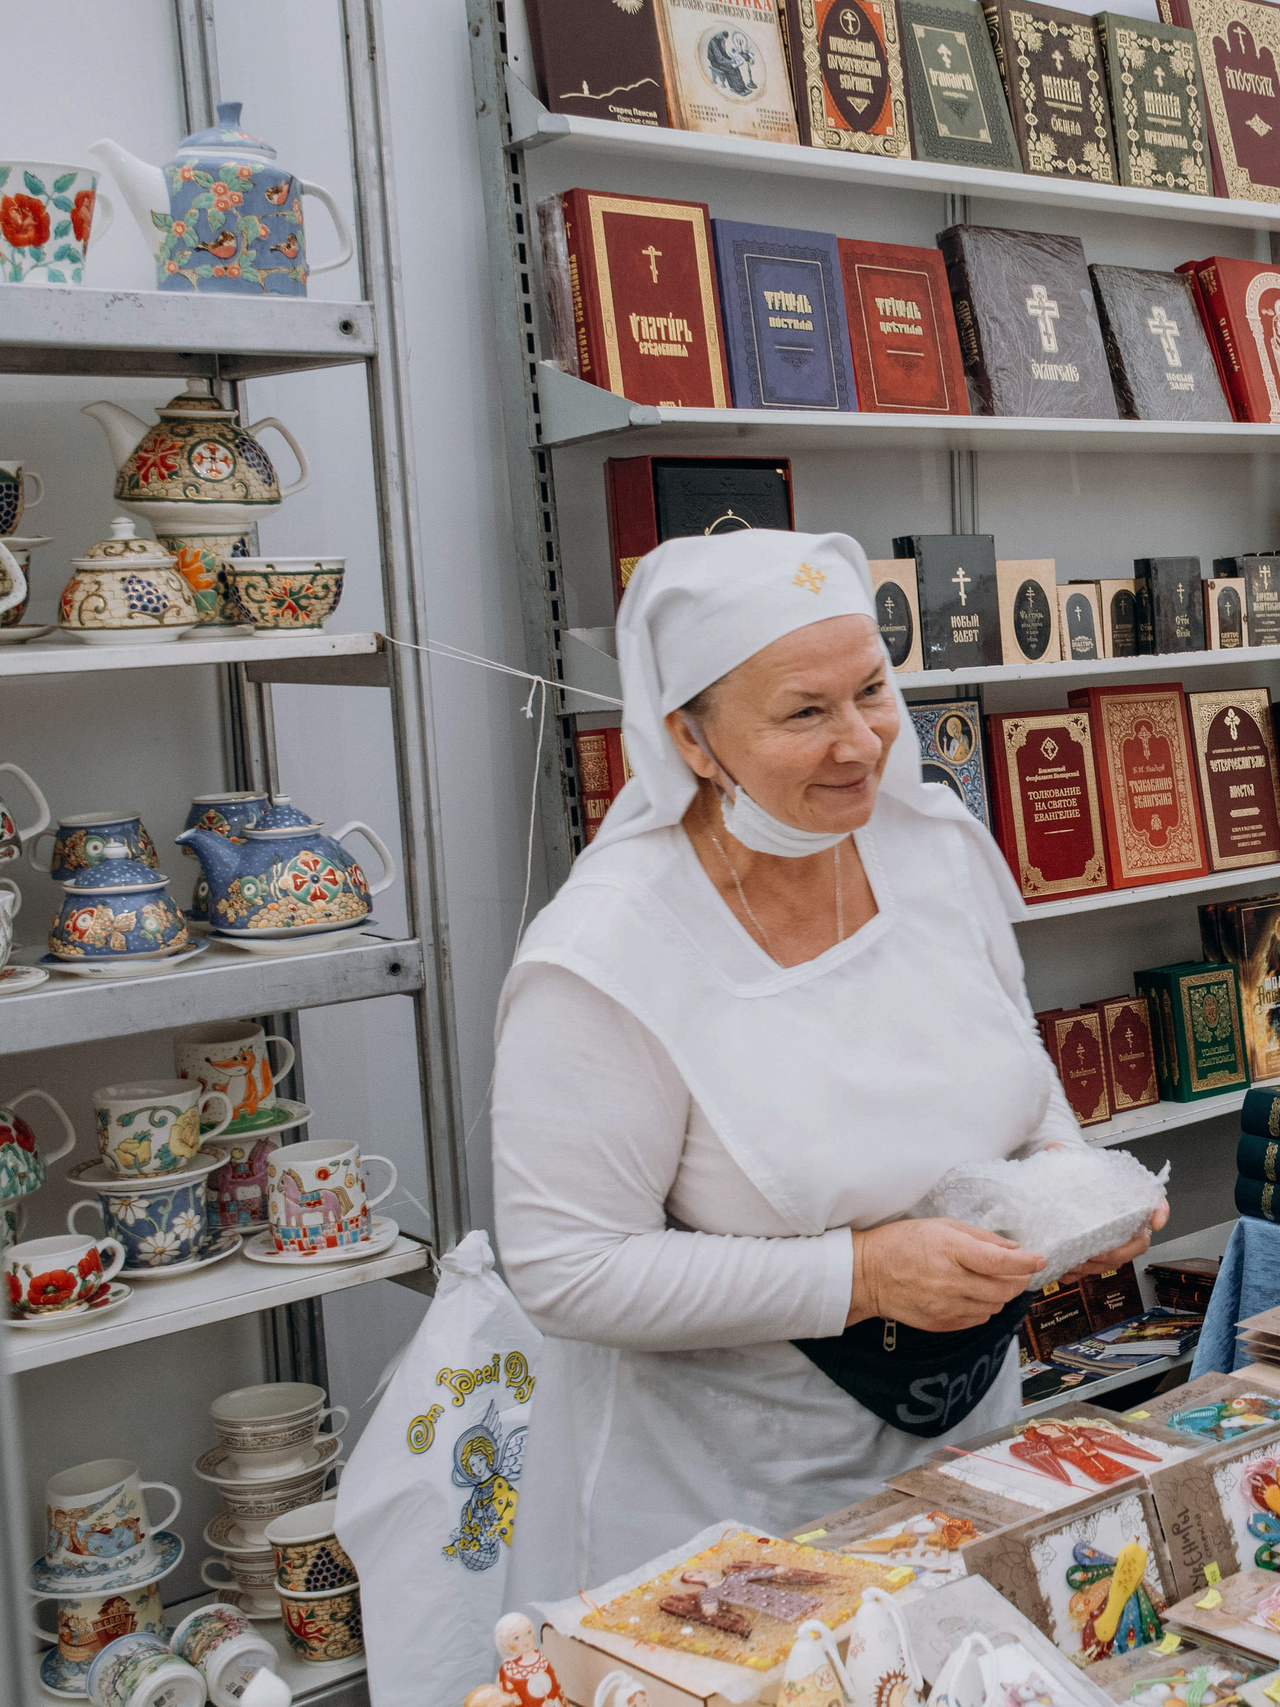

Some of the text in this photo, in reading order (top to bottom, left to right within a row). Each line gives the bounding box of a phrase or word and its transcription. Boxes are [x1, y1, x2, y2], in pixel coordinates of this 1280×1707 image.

[608, 104, 658, 118] Старец Паисий
[617, 115, 641, 124] Простые
[1166, 373, 1195, 384] НОВЫЙ
[1170, 383, 1195, 392] ЗАВЕТ
[951, 614, 979, 628] НОВЫЙ
[953, 629, 978, 643] ЗАВЕТ
[1025, 770, 1080, 782] Феофилакт Болгарский
[1038, 765, 1066, 774] Блаженный
[1028, 786, 1081, 800] ТОЛКОВАНИЕ
[1035, 798, 1077, 811] НА СВЯТОЕ
[1034, 809, 1081, 823] ЕВАНГЕЛИЕ
[407, 1404, 444, 1454] От
[437, 1353, 501, 1407] Всей
[1195, 1512, 1213, 1558] стекла
